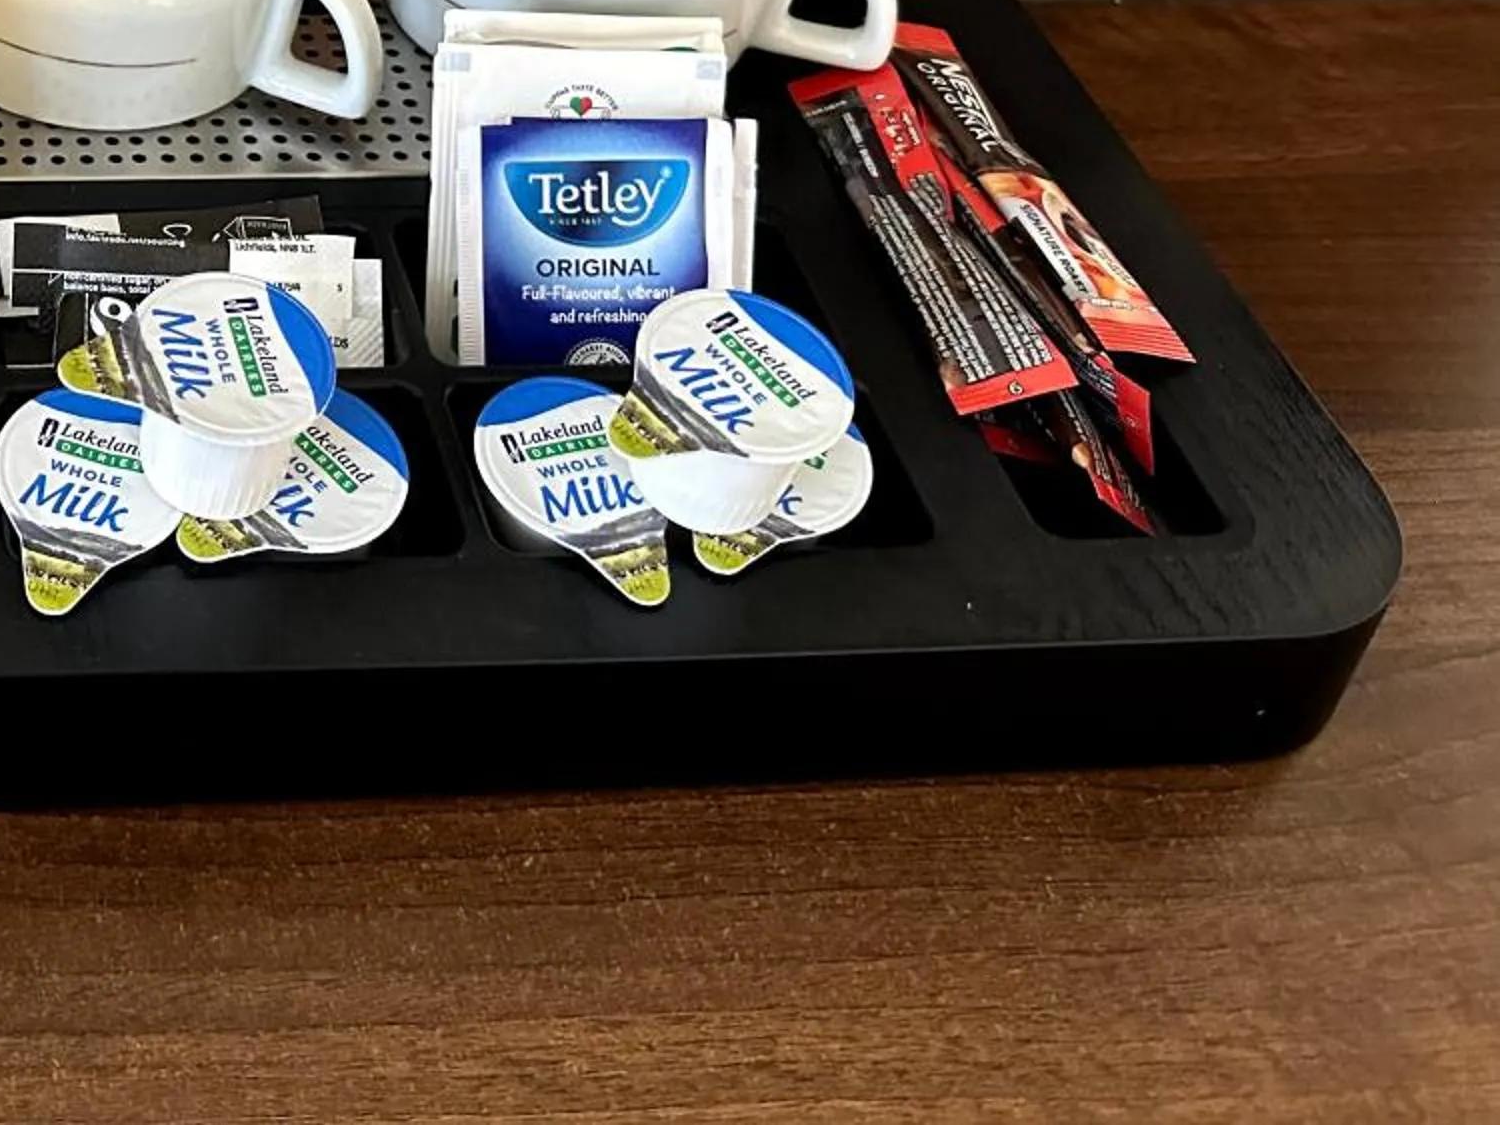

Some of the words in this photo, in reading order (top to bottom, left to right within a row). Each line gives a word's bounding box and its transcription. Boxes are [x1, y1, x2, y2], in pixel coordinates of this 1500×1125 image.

[917, 62, 999, 153] ORIGINAL
[528, 171, 666, 227] Tetley
[536, 258, 661, 278] ORIGINAL
[1020, 204, 1065, 256] SIGNATURE
[1059, 258, 1089, 294] ROAST
[550, 308, 575, 324] and
[151, 308, 214, 401] Milk
[205, 318, 238, 385] WHOLE
[231, 321, 264, 393] DAIRIES
[247, 315, 289, 395] Lakeland
[704, 341, 770, 406] WHOLE
[726, 338, 796, 404] DAIRIES
[734, 325, 818, 401] Lakeland
[653, 346, 756, 436] Milk
[61, 423, 141, 457] Lakelan
[306, 425, 376, 485] akeland
[519, 414, 604, 447] Lakeland
[51, 458, 124, 488] WHOLE
[289, 456, 328, 494] OLE
[299, 438, 356, 490] AIRIES
[536, 454, 609, 479] WHOLE
[18, 473, 129, 533] Milk
[269, 475, 315, 527] lk
[539, 473, 645, 524] Milk
